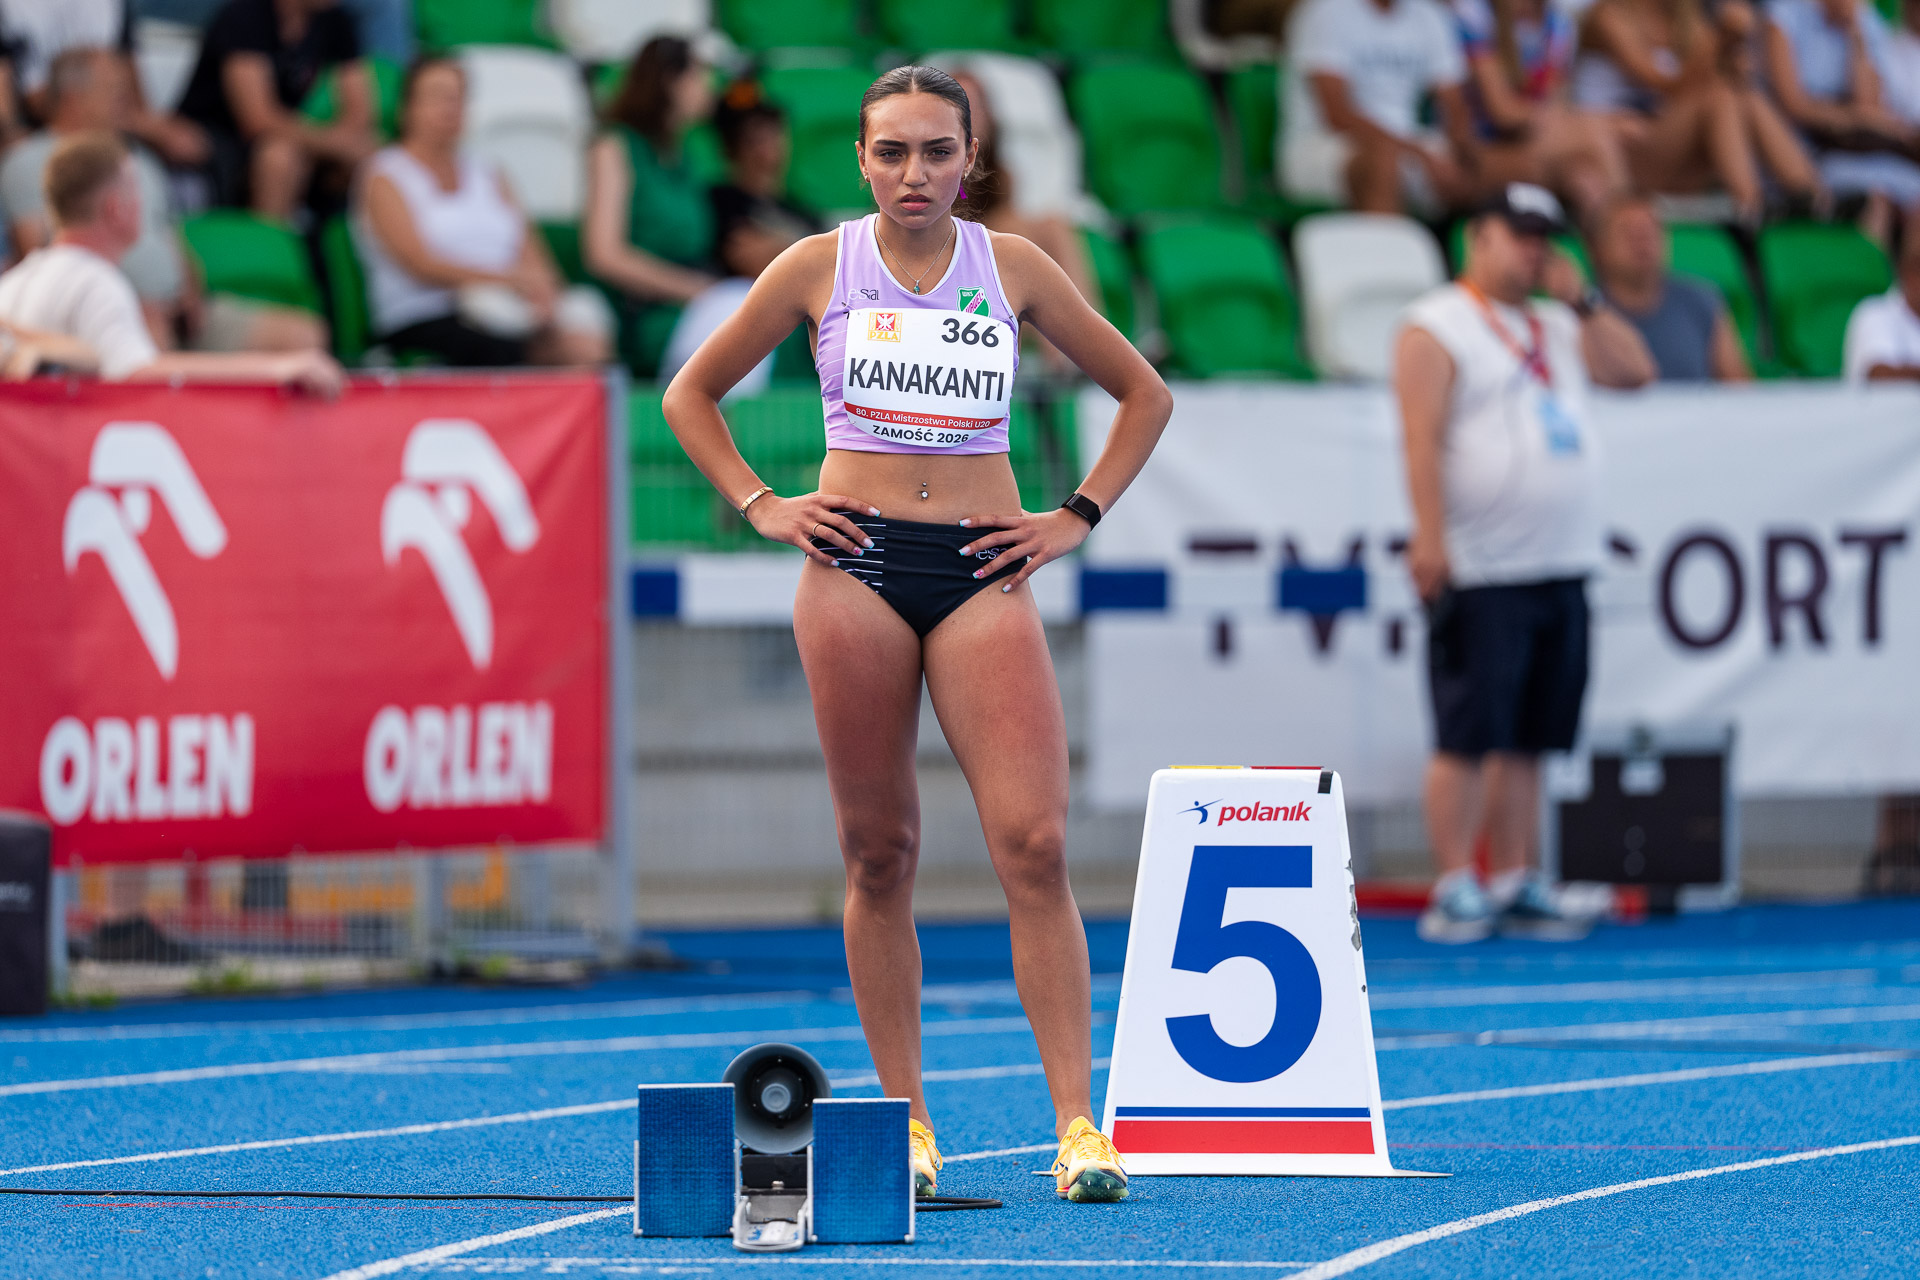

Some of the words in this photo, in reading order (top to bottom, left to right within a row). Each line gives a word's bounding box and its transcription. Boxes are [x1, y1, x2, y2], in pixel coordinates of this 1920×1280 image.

[869, 331, 899, 341] PZLA
[941, 317, 999, 348] 366
[848, 357, 1005, 402] KANAKANTI
[855, 407, 869, 417] 80.
[870, 411, 891, 421] PZLA
[892, 414, 946, 426] Mistrzostwa
[947, 417, 973, 429] Polski
[974, 420, 991, 429] U20
[872, 424, 934, 443] ZAMOŚĆ
[936, 432, 969, 444] 2026
[40, 712, 255, 826] ORLEN
[363, 701, 555, 814] ORLEN
[1217, 800, 1313, 826] polanik
[1165, 845, 1322, 1084] 5
